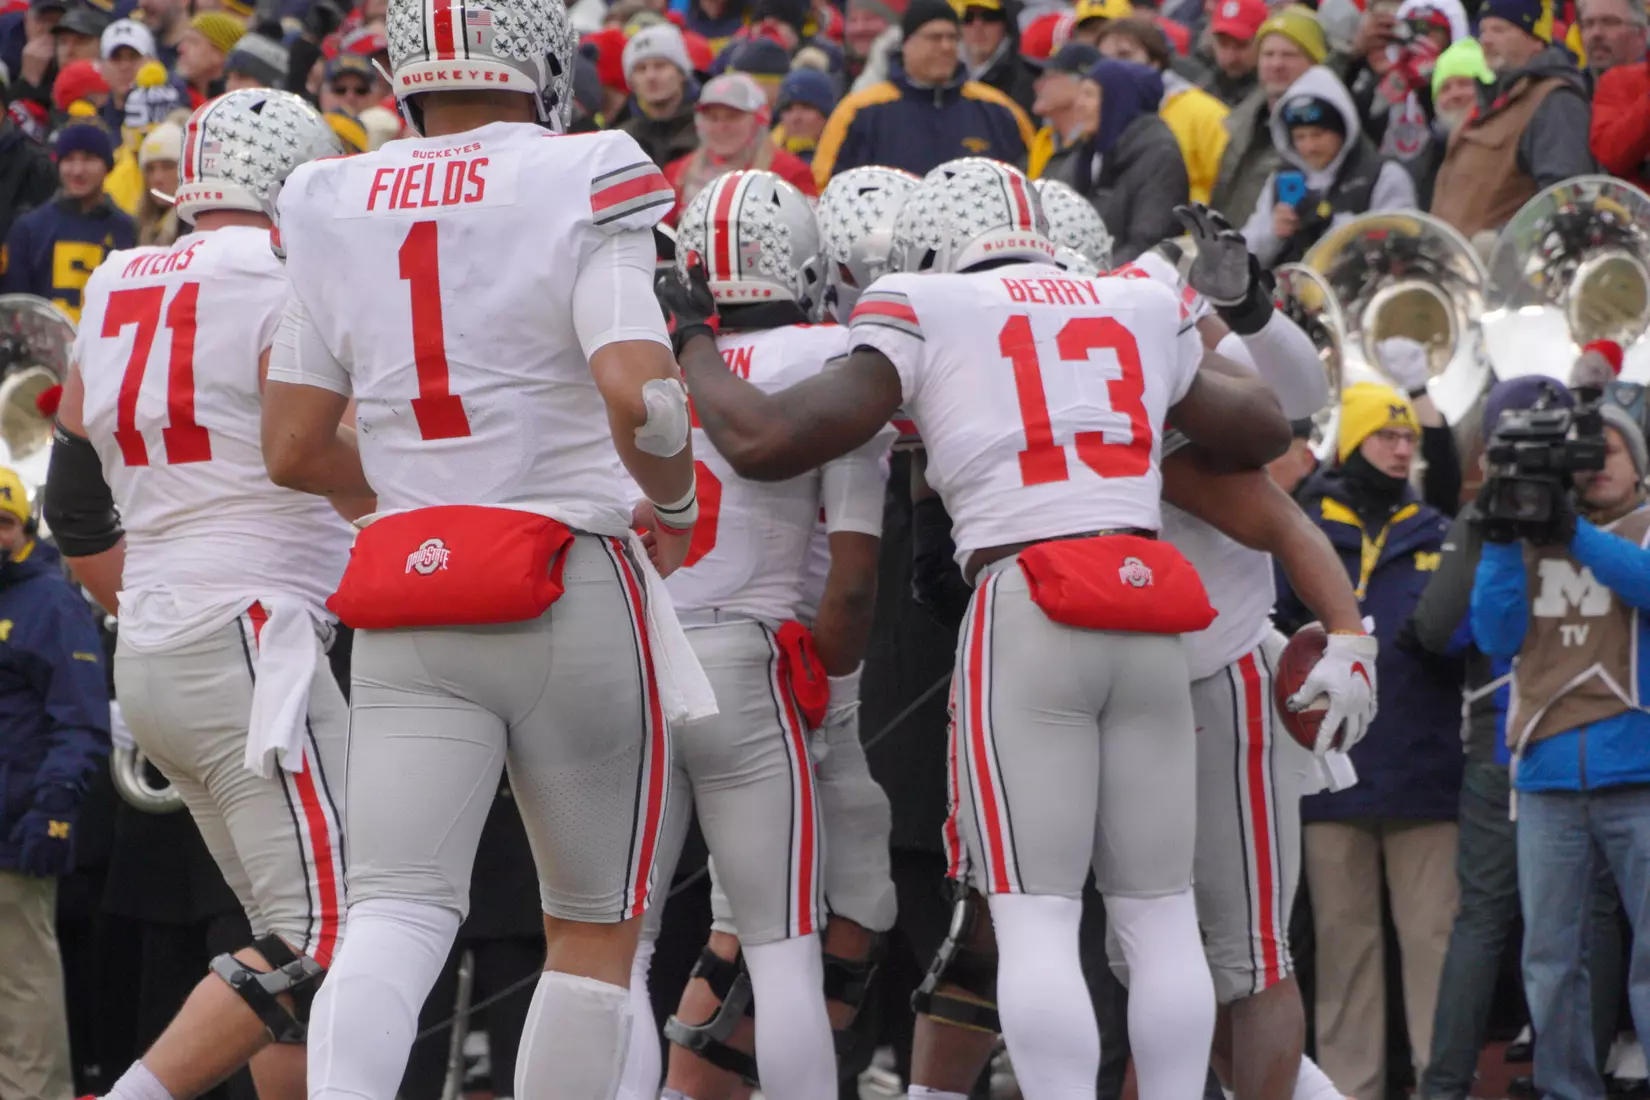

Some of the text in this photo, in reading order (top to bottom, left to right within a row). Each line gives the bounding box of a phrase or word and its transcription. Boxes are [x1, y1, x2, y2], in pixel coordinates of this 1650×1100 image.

[402, 70, 510, 85] BUCKEYES
[412, 142, 482, 159] BUCKEYES
[366, 157, 490, 211] FIELDS
[1000, 277, 1101, 305] BERRY
[398, 220, 472, 441] 1
[100, 281, 212, 467] 71
[998, 314, 1153, 487] 13
[1532, 558, 1612, 618] M
[1559, 624, 1591, 647] TV
